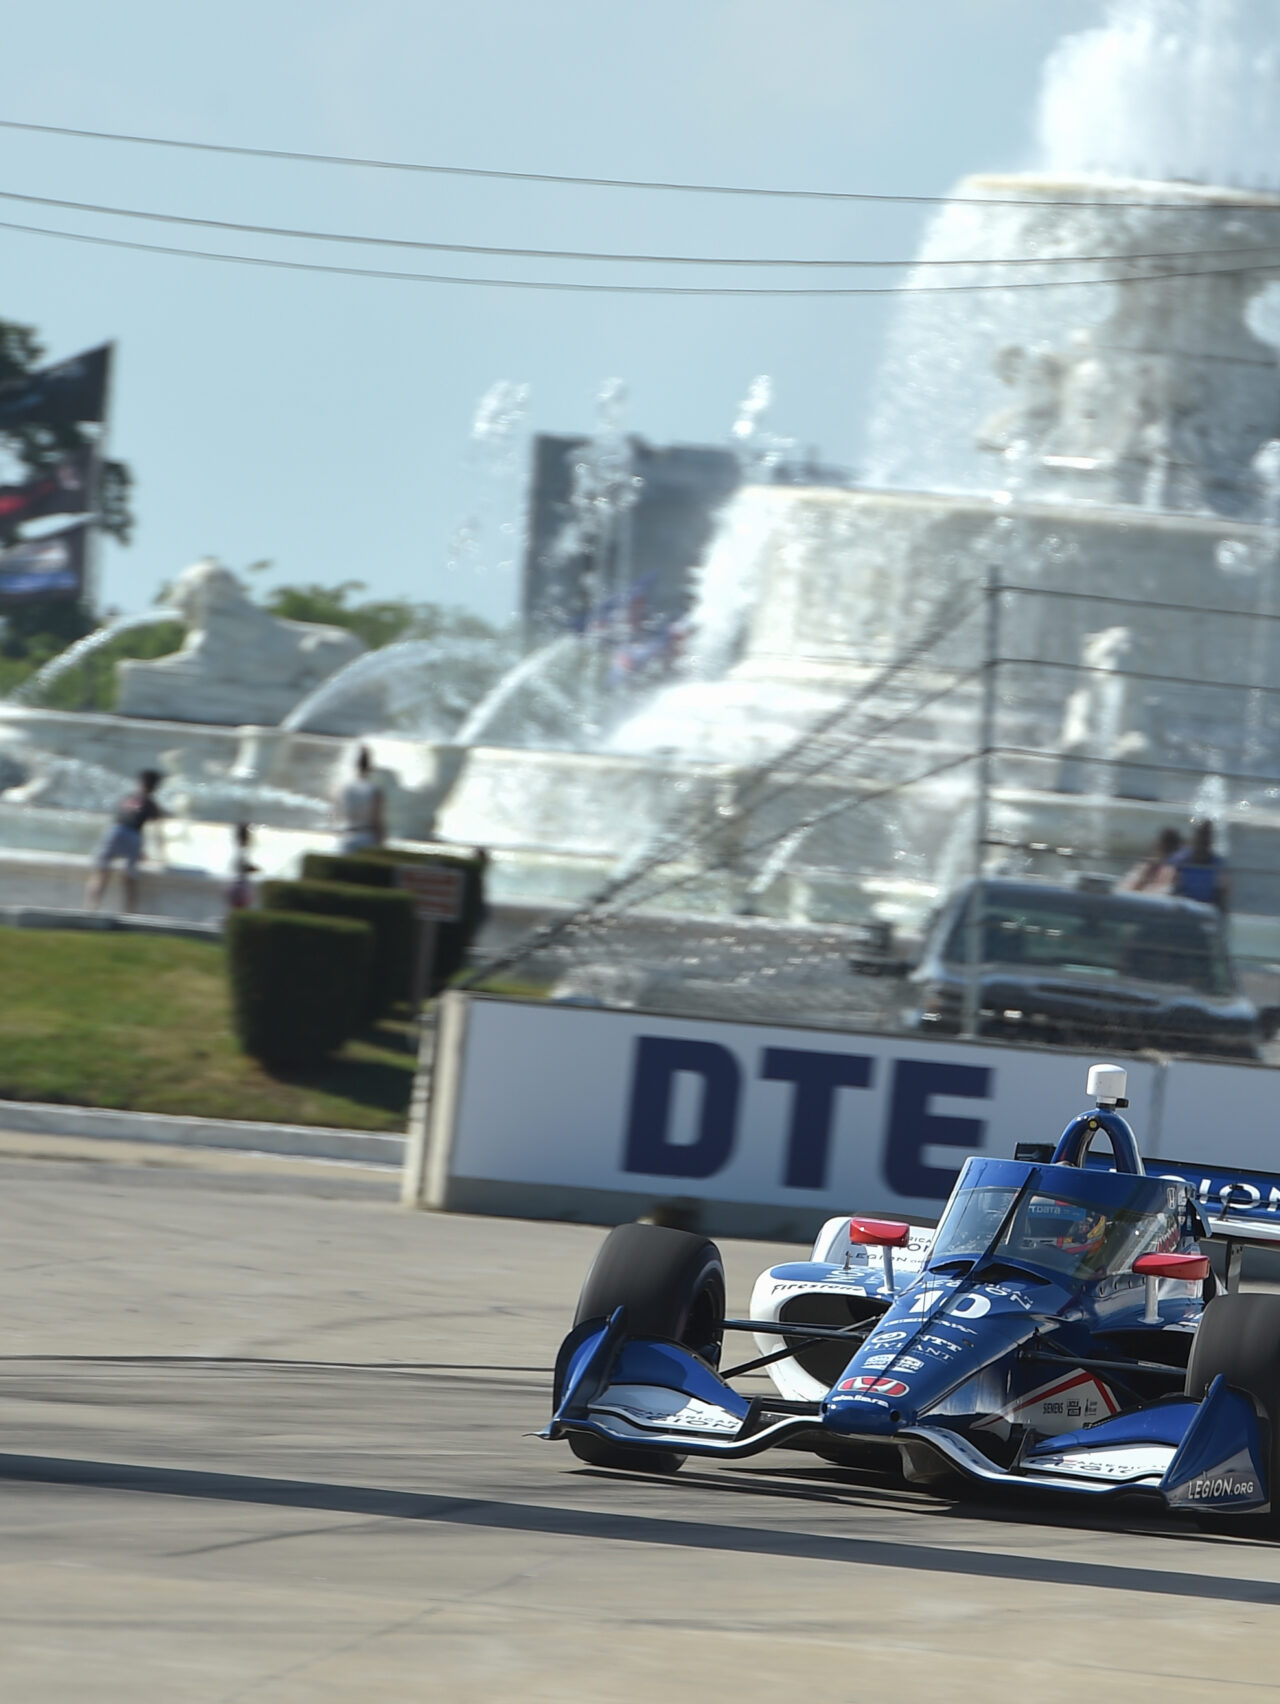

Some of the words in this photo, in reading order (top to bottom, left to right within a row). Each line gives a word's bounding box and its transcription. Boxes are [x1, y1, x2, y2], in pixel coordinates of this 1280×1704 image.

[622, 1034, 996, 1199] DTE
[908, 1290, 992, 1319] 10
[1188, 1478, 1254, 1499] LEGION.ORG
